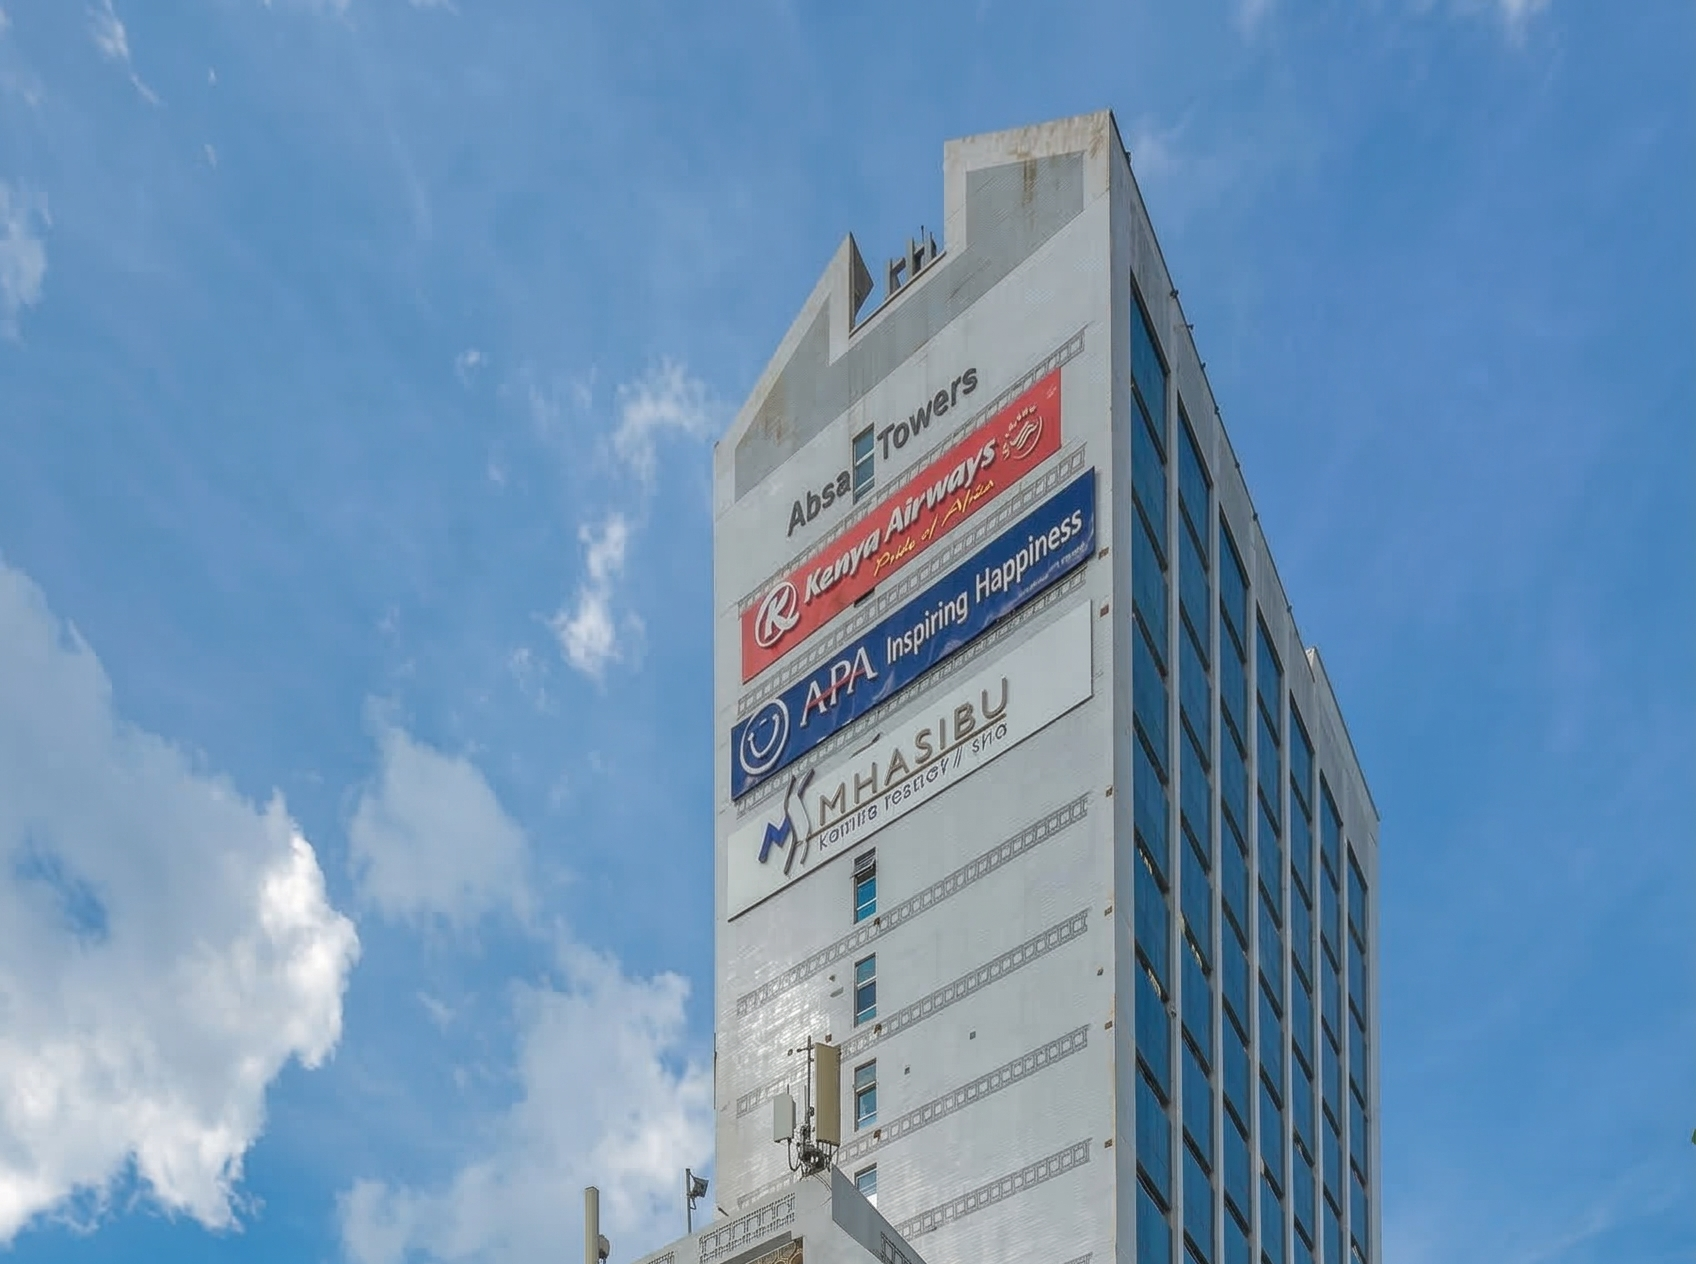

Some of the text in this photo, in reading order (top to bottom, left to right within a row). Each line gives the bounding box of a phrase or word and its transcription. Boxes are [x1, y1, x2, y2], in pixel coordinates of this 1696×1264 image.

[786, 469, 852, 537] Absa
[877, 367, 979, 460] Towers
[803, 528, 881, 604] Kenya
[883, 437, 998, 543] Airways
[800, 646, 879, 728] APA
[886, 590, 968, 665] Inspiring
[975, 508, 1084, 604] Happiness
[819, 676, 1008, 827] MHASIBU
